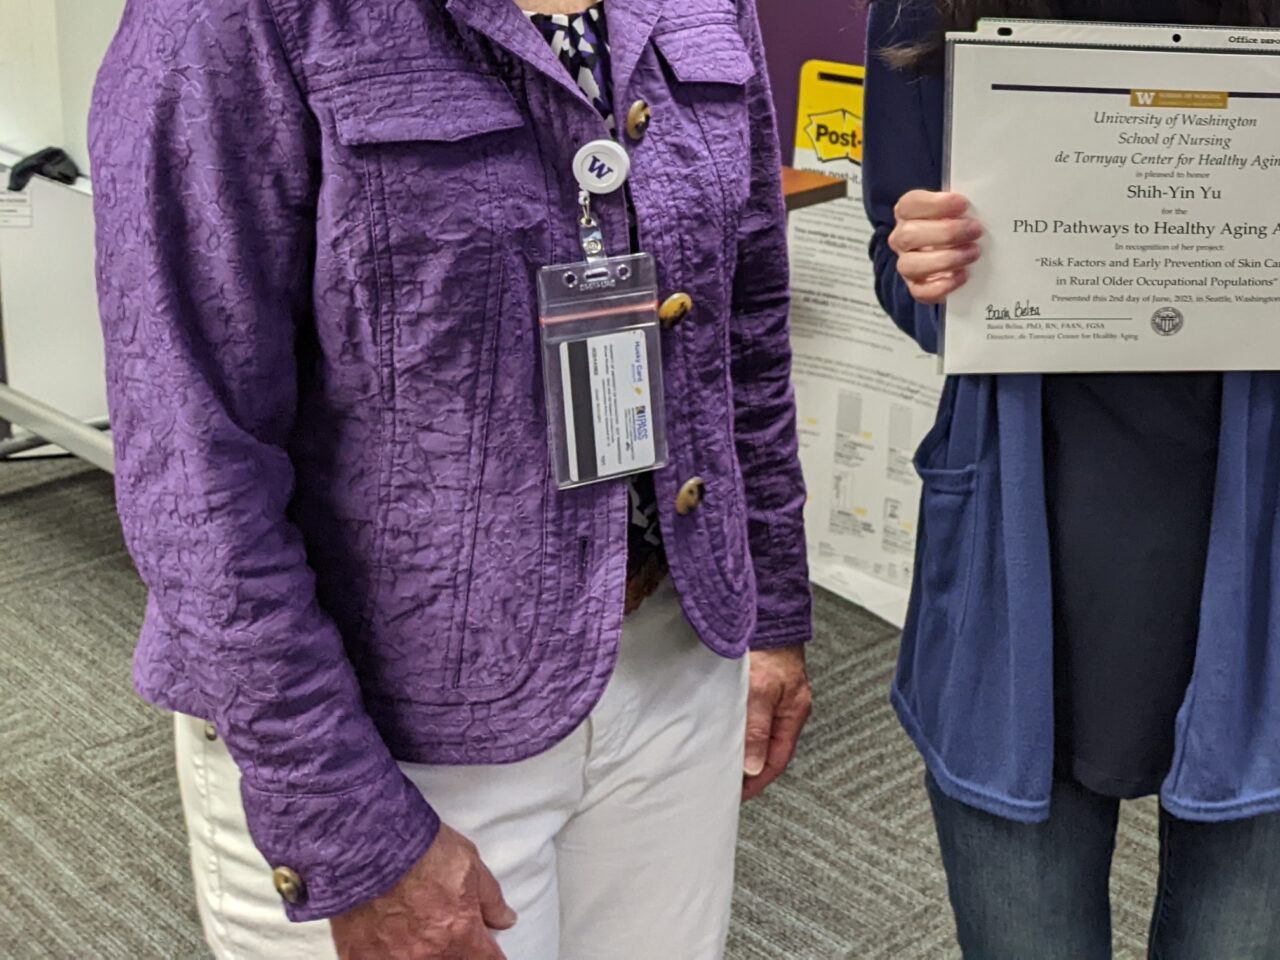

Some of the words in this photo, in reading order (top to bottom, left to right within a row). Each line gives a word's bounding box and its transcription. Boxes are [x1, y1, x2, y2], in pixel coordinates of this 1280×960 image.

[1135, 92, 1155, 105] W
[1094, 112, 1162, 128] University
[1164, 114, 1181, 129] of
[1182, 114, 1257, 130] Washington
[1118, 133, 1159, 145] School
[1162, 134, 1176, 149] of
[1178, 134, 1232, 149] Nursing
[1055, 151, 1070, 163] de
[1074, 152, 1127, 167] Tornyay
[1131, 153, 1173, 165] Center
[1175, 154, 1195, 169] for
[1198, 154, 1248, 169] Healthy
[588, 155, 614, 181] W
[1144, 171, 1174, 180] pleased
[1127, 185, 1195, 200] Shih-Yin
[1200, 187, 1221, 200] Yu
[1013, 220, 1048, 234] PhD
[1053, 220, 1130, 238] Pathways
[1134, 222, 1149, 234] to
[1154, 221, 1215, 238] Healthy
[1220, 223, 1267, 239] Aging
[1125, 243, 1169, 252] recognition
[1067, 258, 1107, 268] Factors
[1109, 258, 1130, 268] and
[1133, 259, 1161, 270] Early
[1164, 259, 1222, 268] Prevention
[1225, 258, 1236, 268] of
[1238, 259, 1261, 268] Skin
[1056, 277, 1066, 286] in
[1070, 276, 1099, 286] Rural
[1103, 276, 1133, 286] Older
[1136, 276, 1207, 289] Occupational
[1126, 295, 1140, 303] day
[1235, 296, 1280, 304] Washington
